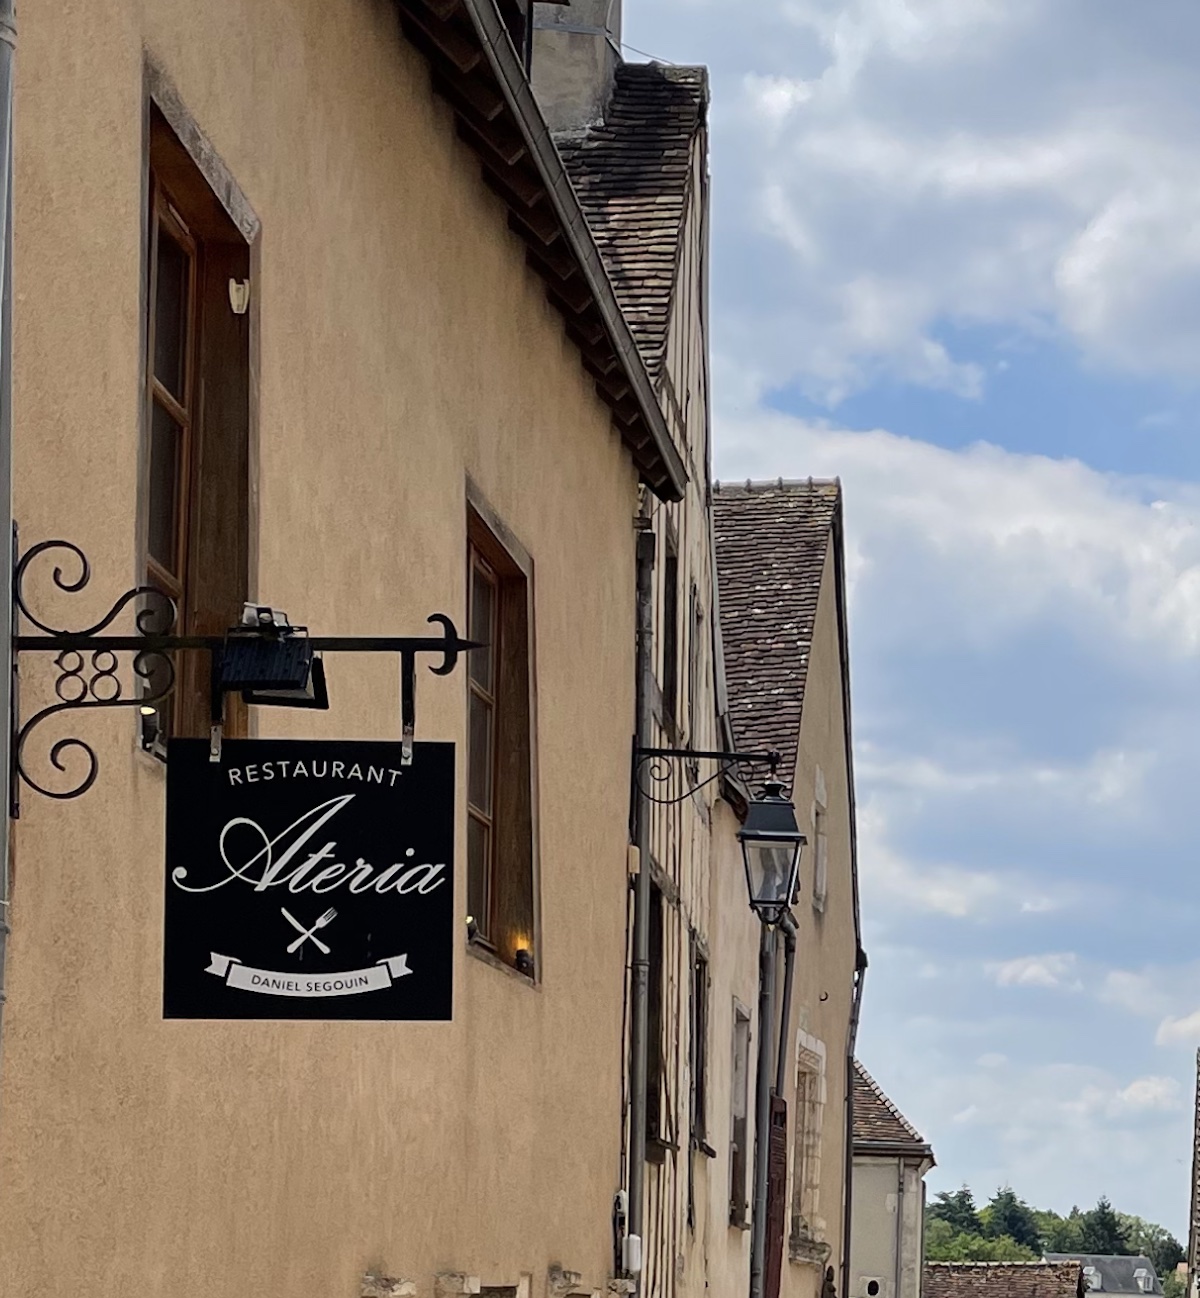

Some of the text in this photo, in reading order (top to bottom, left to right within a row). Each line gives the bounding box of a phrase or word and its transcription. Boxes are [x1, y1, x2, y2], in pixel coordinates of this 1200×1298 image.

[228, 760, 402, 787] RESTAURANT
[172, 794, 446, 895] Ateria
[251, 974, 369, 992] DANIEL SEGOUIN
